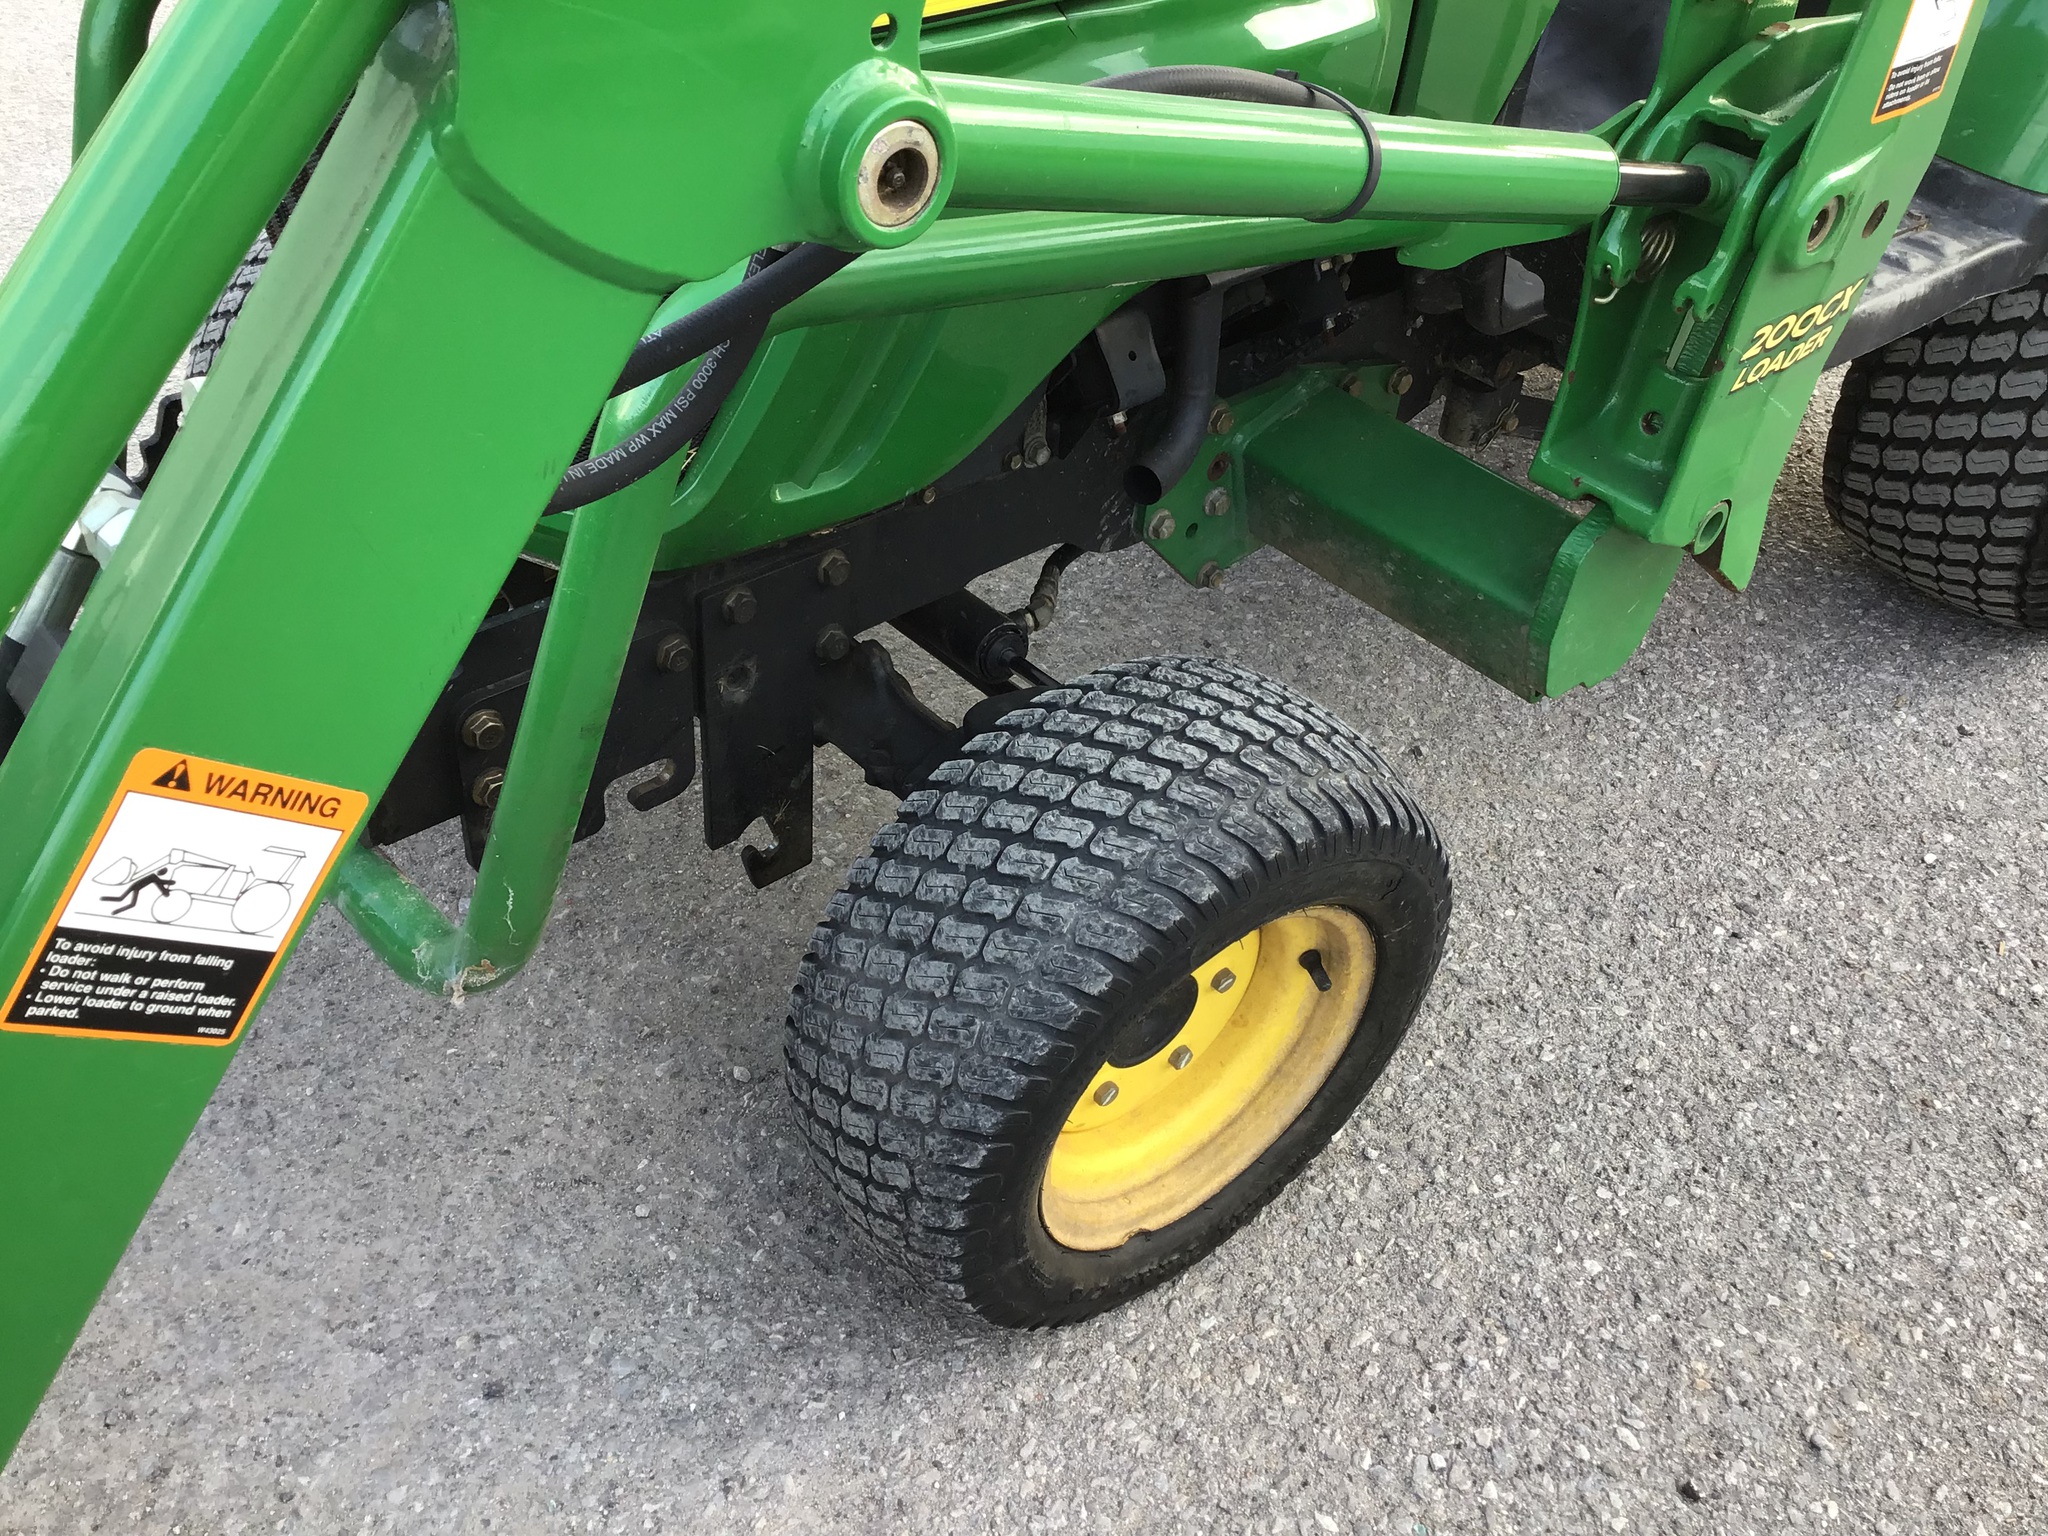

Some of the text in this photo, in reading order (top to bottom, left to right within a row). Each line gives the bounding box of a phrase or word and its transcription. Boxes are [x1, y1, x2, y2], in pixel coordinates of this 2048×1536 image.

[1740, 277, 1866, 362] 200CX
[1729, 324, 1834, 393] LOADER
[692, 356, 718, 391] 3000
[677, 388, 697, 413] PSI
[647, 410, 679, 438] MAX
[625, 431, 652, 454] WP
[567, 469, 587, 481] IN
[588, 447, 628, 475] MADE
[204, 772, 342, 819] WARNING
[45, 951, 98, 967] loader:
[54, 937, 235, 971] To avoid injury from falling
[48, 965, 206, 991] Do not walk or perform
[34, 991, 232, 1019] Lower loader to ground when
[40, 980, 237, 1007] service under a raised loader.
[24, 1005, 80, 1019] parked.
